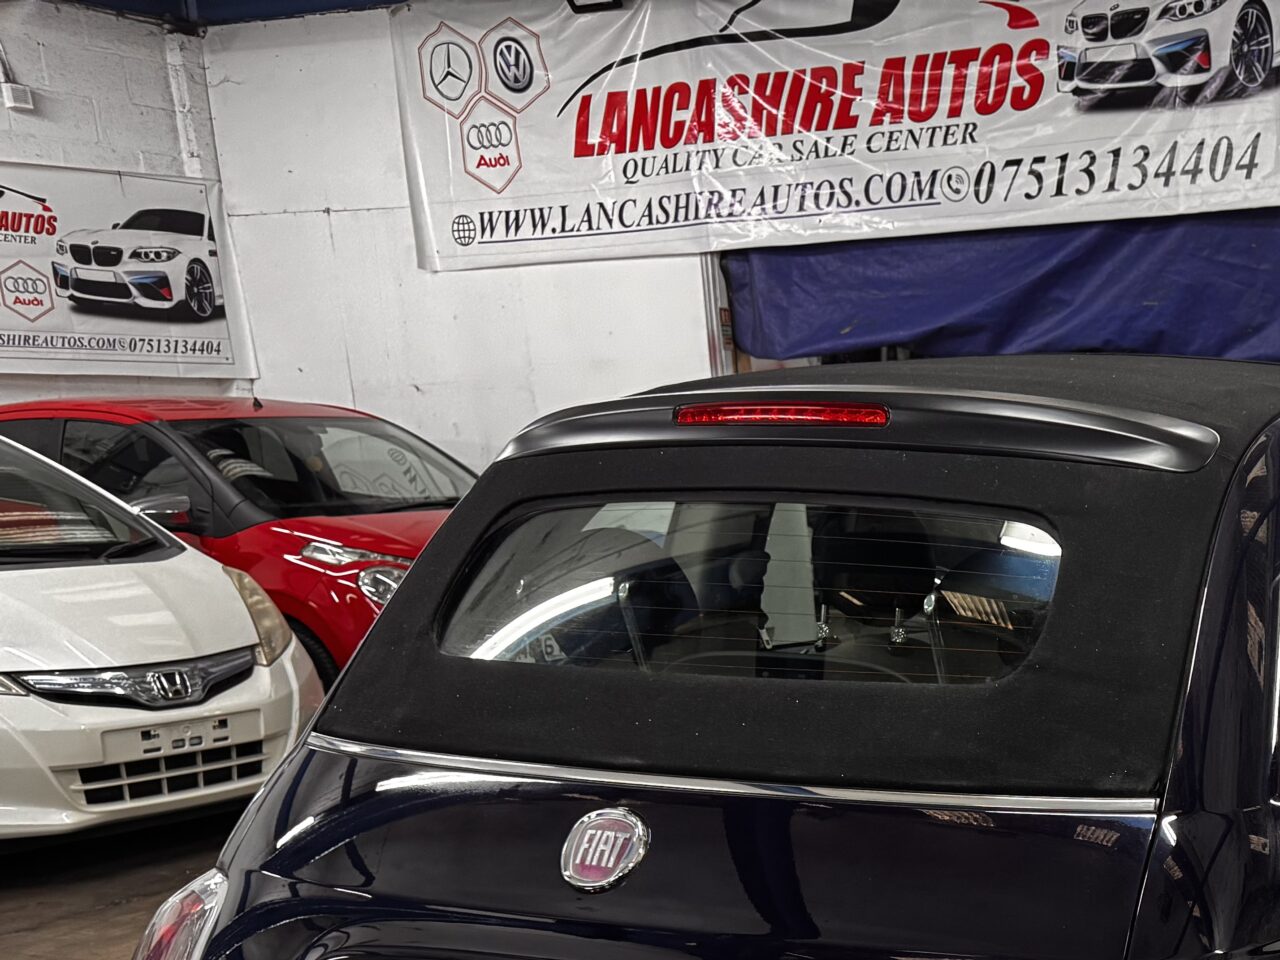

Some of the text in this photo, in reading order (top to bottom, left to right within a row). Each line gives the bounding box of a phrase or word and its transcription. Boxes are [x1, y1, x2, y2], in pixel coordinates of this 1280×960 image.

[573, 38, 1050, 158] LANCASHIRE AUTOS
[476, 153, 510, 169] Audi
[622, 147, 726, 184] QUALITY
[790, 134, 858, 162] SALE
[866, 122, 979, 154] CENTER
[973, 132, 1262, 205] 07513134404
[0, 211, 58, 236] AUTOS
[478, 168, 941, 240] WWW.LANCASHIREAUTOS.COM
[13, 296, 44, 307] Audi
[129, 338, 222, 356] 07513134404
[575, 829, 631, 868] FIAT
